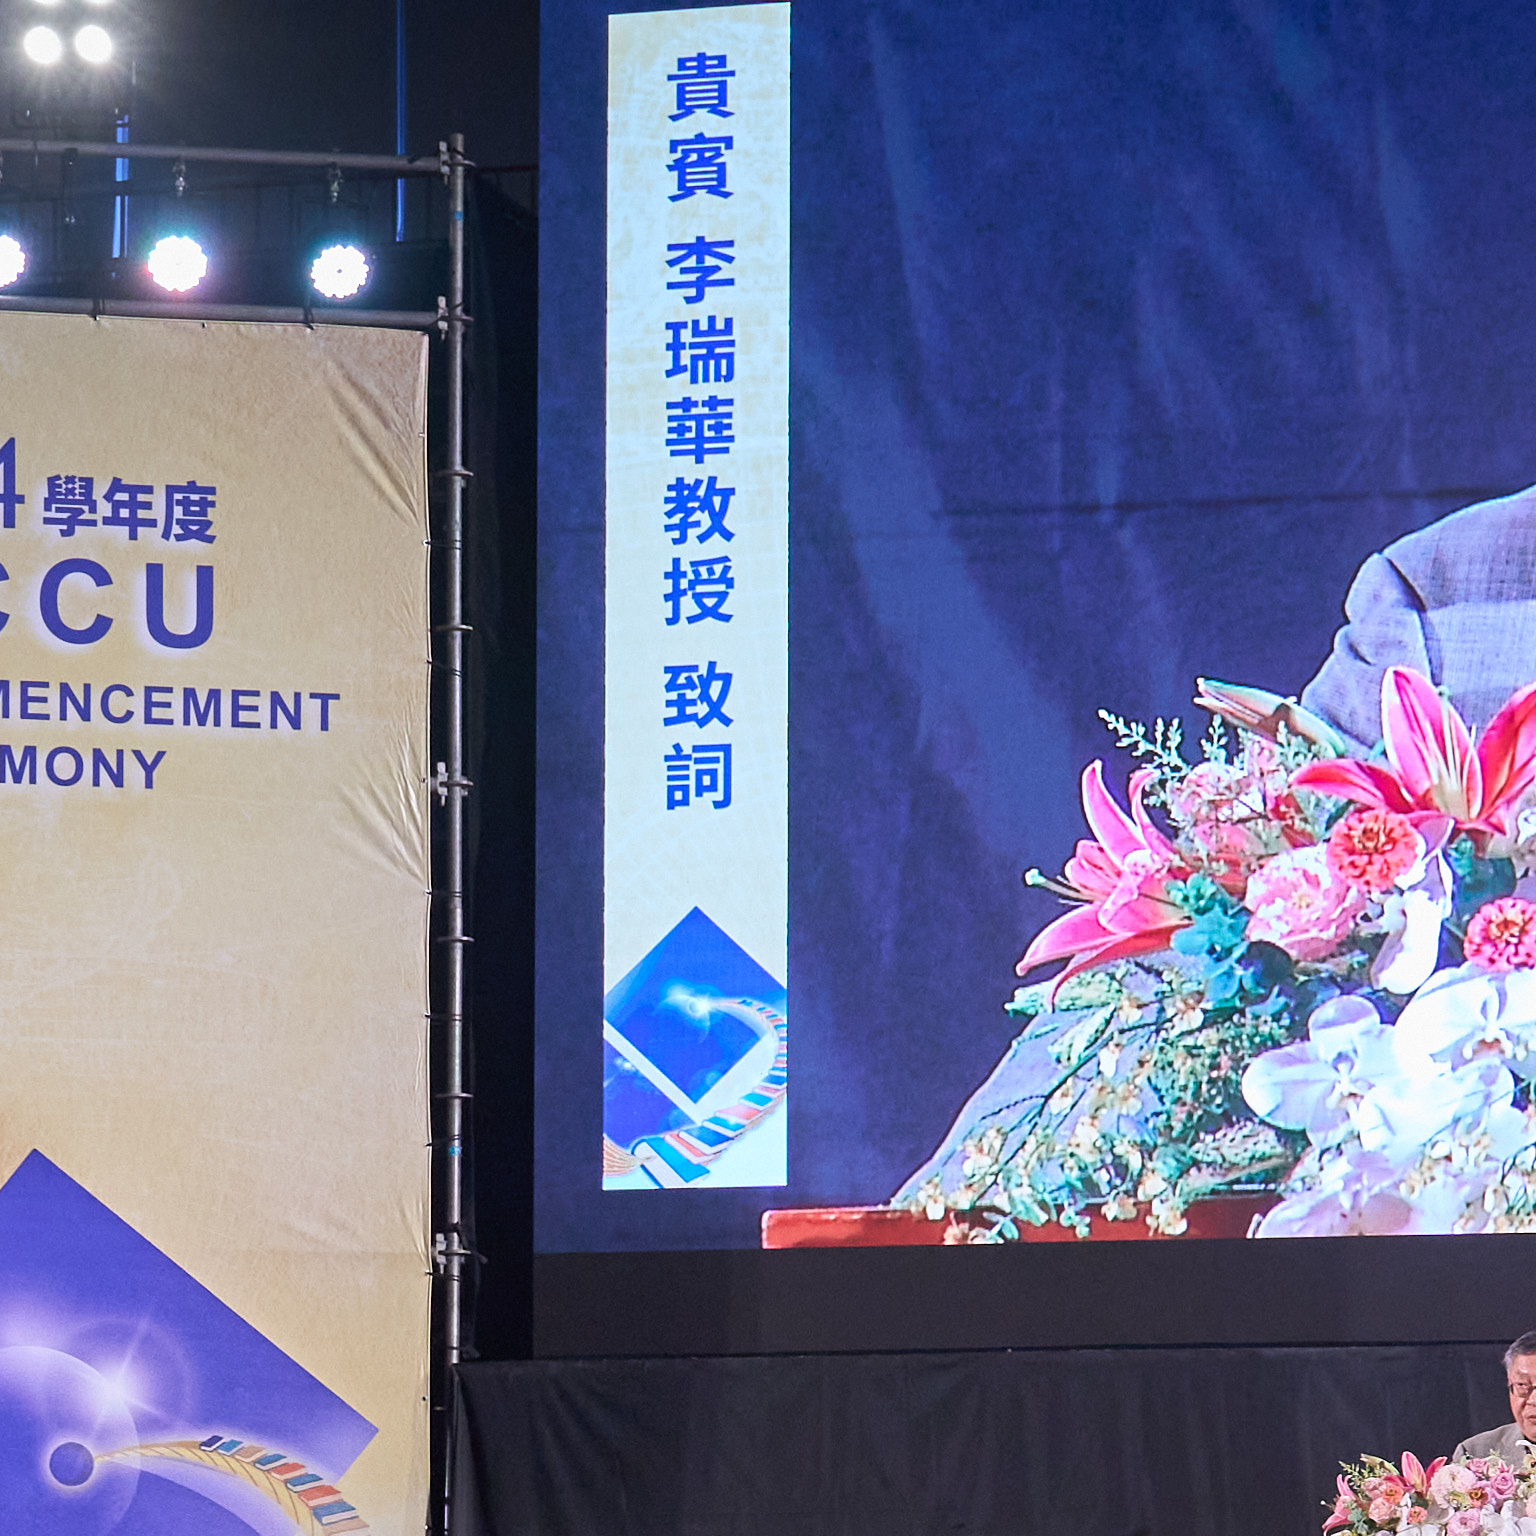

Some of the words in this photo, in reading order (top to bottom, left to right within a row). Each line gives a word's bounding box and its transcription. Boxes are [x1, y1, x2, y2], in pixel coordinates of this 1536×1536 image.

[666, 52, 736, 203] 貴賓
[663, 235, 736, 627] 李瑞華教授
[42, 474, 217, 545] 學年度
[662, 660, 735, 811] 致詞
